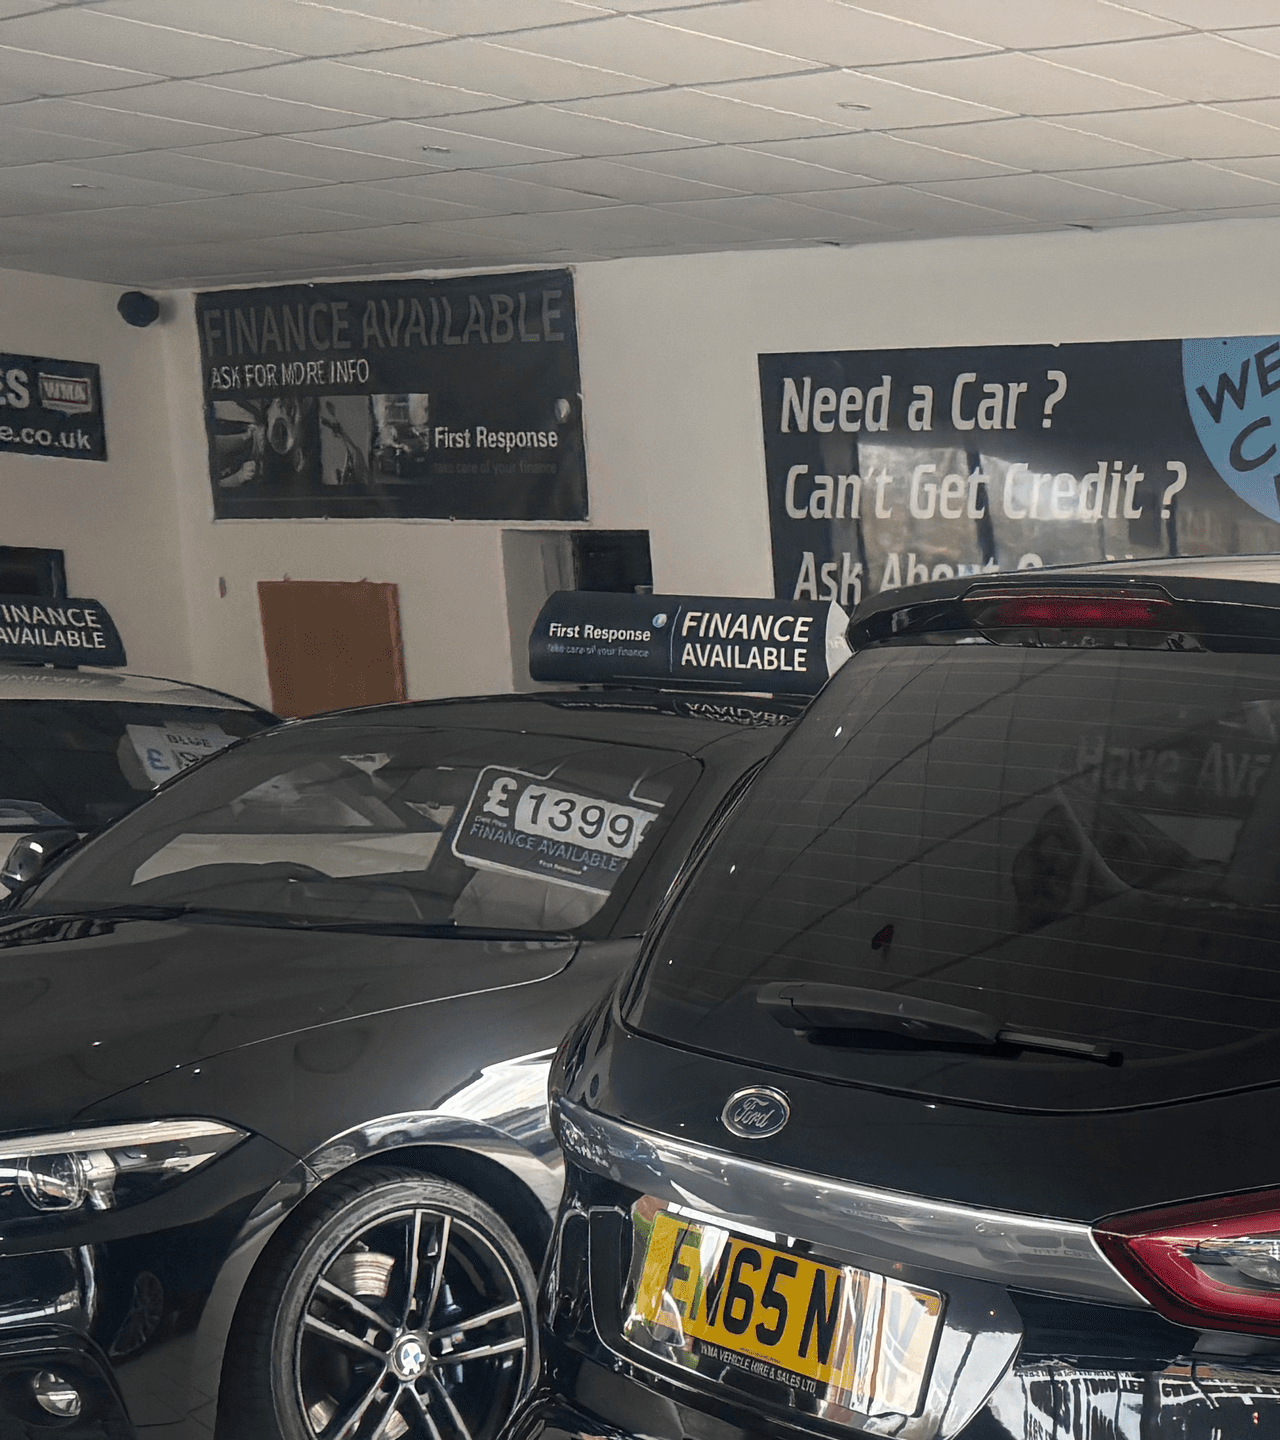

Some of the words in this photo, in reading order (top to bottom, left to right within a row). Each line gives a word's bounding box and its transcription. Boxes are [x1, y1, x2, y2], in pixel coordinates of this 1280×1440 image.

[204, 302, 350, 356] FINANCE
[362, 290, 564, 348] AVAILABLE
[212, 366, 240, 389] ASK
[245, 364, 277, 387] FOR
[282, 360, 324, 385] MORE
[330, 359, 369, 384] INFO
[780, 375, 891, 433] Need
[907, 387, 933, 431] a
[951, 373, 1027, 430] Car
[1042, 370, 1068, 428] ?
[435, 427, 471, 448] First
[476, 426, 558, 453] Response
[784, 464, 893, 519] Can't
[909, 462, 989, 520] Get
[1001, 461, 1145, 520] Credit
[1157, 461, 1187, 519] ?
[793, 551, 862, 606] Ask
[0, 604, 102, 628] INANCE
[681, 611, 814, 643] FINANCE
[549, 623, 580, 638] First
[584, 624, 651, 643] Response
[681, 643, 807, 672] AVAILABLE
[470, 823, 537, 850] FINANCE
[538, 840, 620, 871] AVAILABLE
[734, 1097, 773, 1128] Ford
[720, 1350, 750, 1371] VEHICLE
[750, 1360, 769, 1377] HIRE
[776, 1370, 801, 1388] SALES
